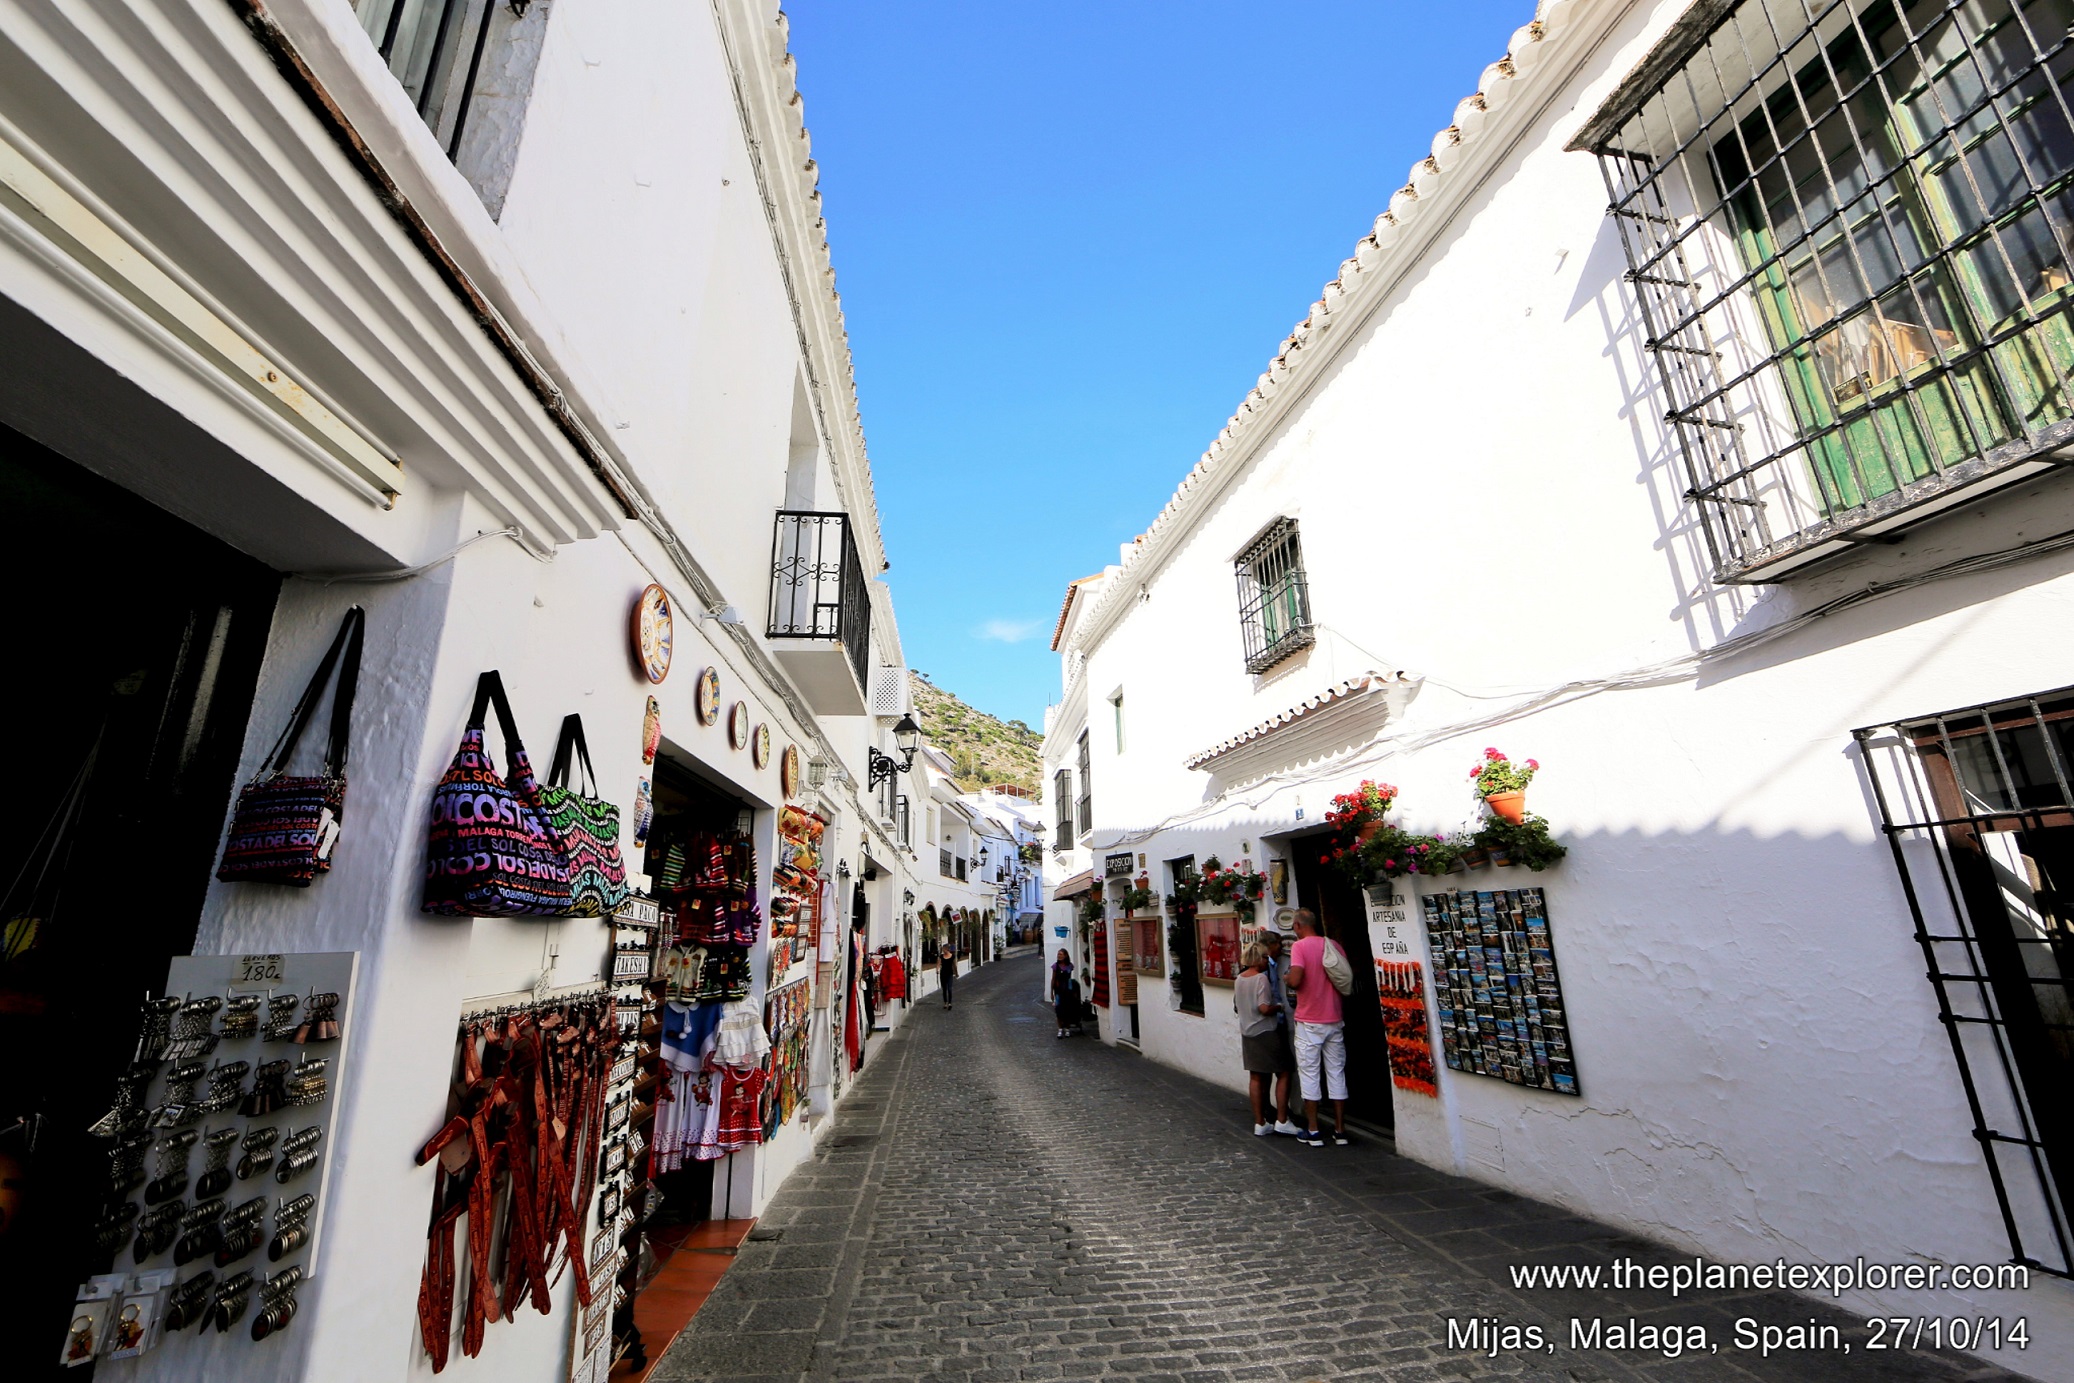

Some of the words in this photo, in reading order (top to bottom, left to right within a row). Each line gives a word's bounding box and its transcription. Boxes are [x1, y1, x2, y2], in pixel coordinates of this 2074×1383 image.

[457, 826, 504, 838] MALAGA
[264, 834, 287, 848] DEL
[491, 837, 516, 853] SOL
[492, 851, 526, 875] SOL
[509, 875, 531, 886] COSTA
[639, 904, 656, 922] PACO
[1387, 926, 1397, 938] DE
[1382, 940, 1409, 954] ESPAÑA
[616, 955, 647, 974] TAKESHI
